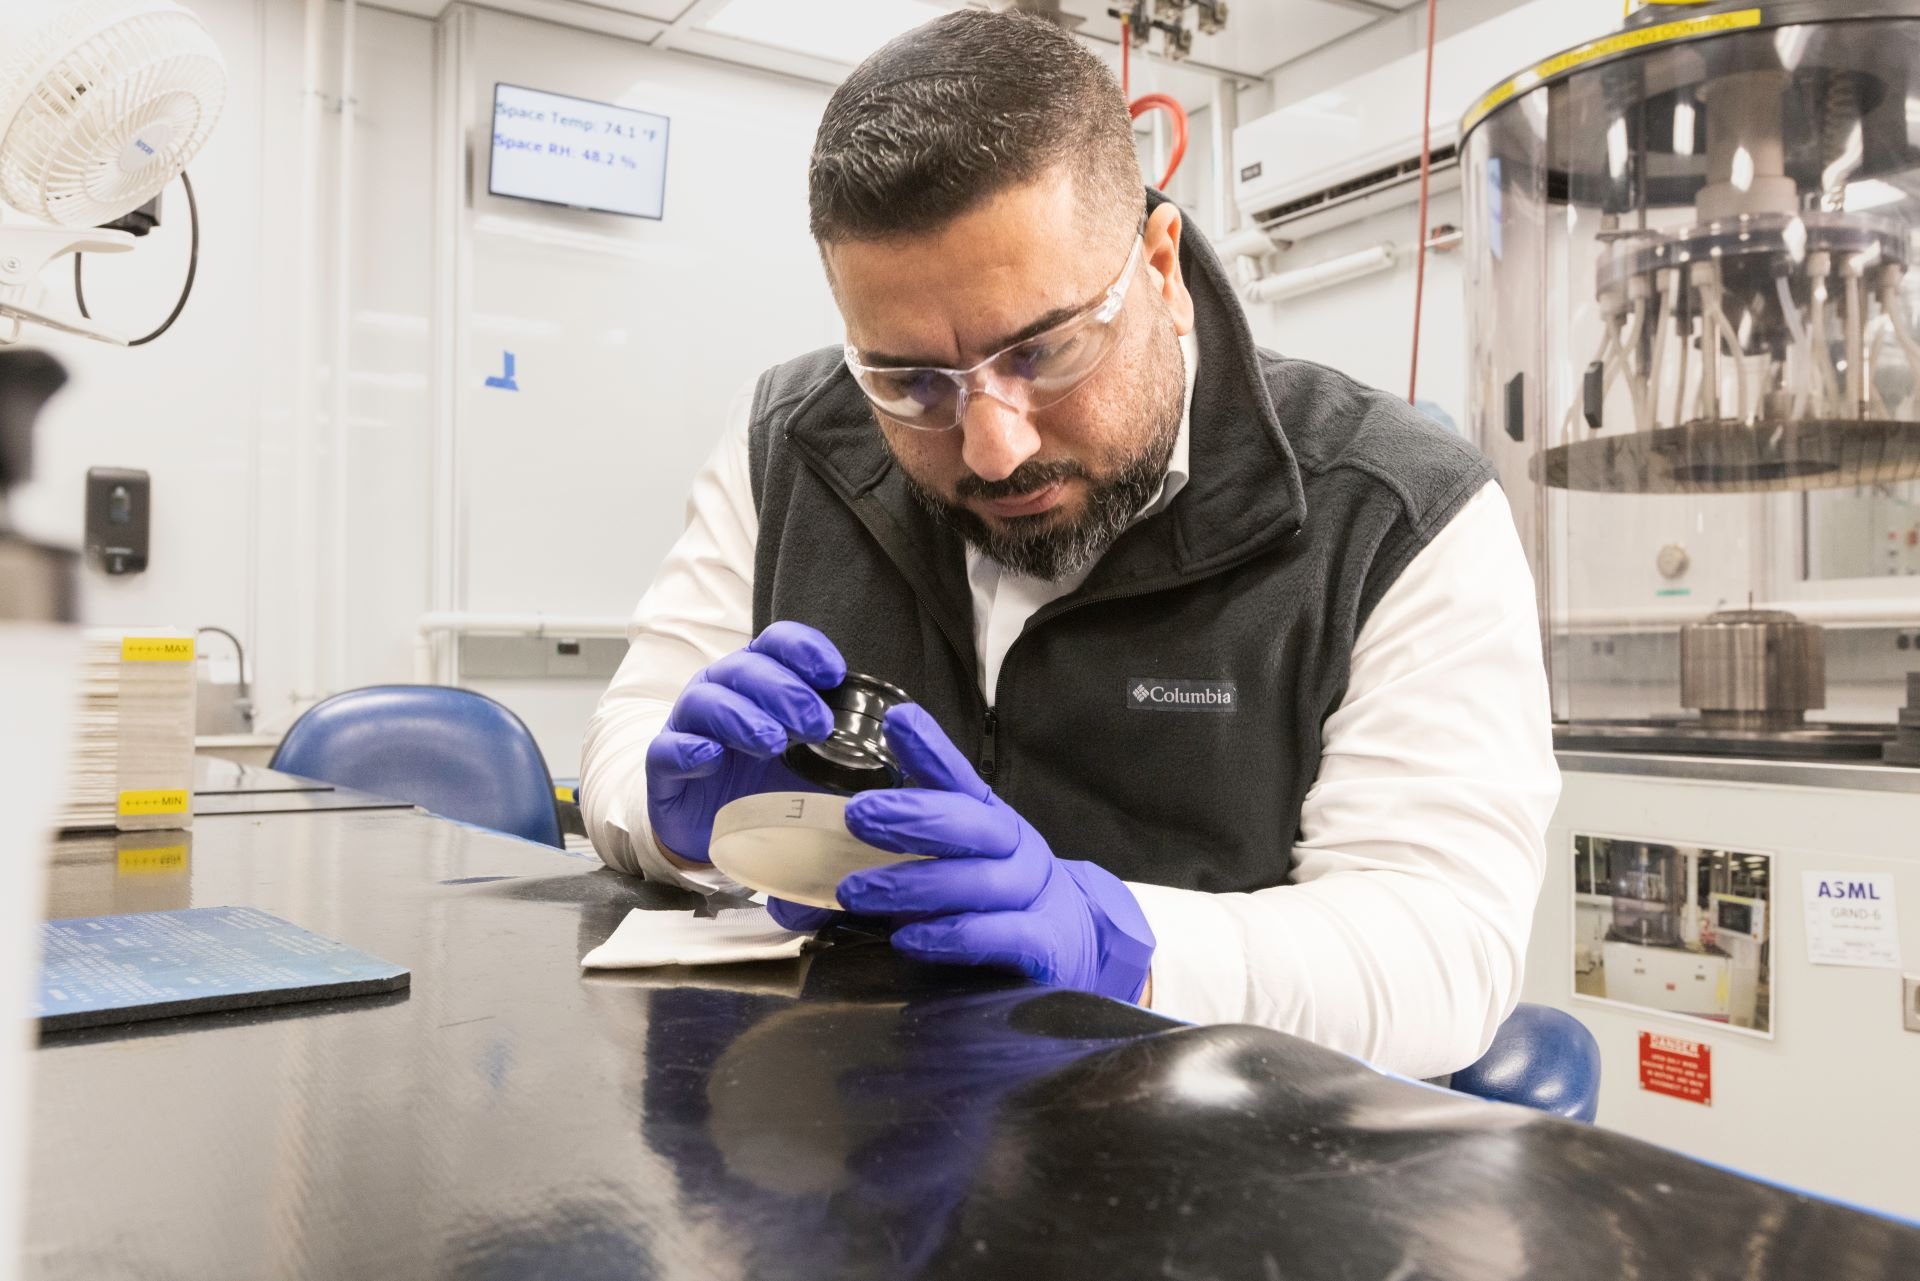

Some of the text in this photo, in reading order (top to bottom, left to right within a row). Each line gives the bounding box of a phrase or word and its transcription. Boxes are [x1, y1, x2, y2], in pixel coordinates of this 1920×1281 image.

[496, 101, 545, 121] Space
[552, 111, 597, 132] Temp:
[603, 121, 636, 139] 74.1
[494, 131, 543, 151] Space
[581, 149, 616, 166] 48.2
[620, 154, 638, 170] %
[163, 644, 189, 654] MAX
[1150, 686, 1231, 704] Columbia
[161, 796, 183, 806] MIN
[1818, 881, 1880, 900] ASML
